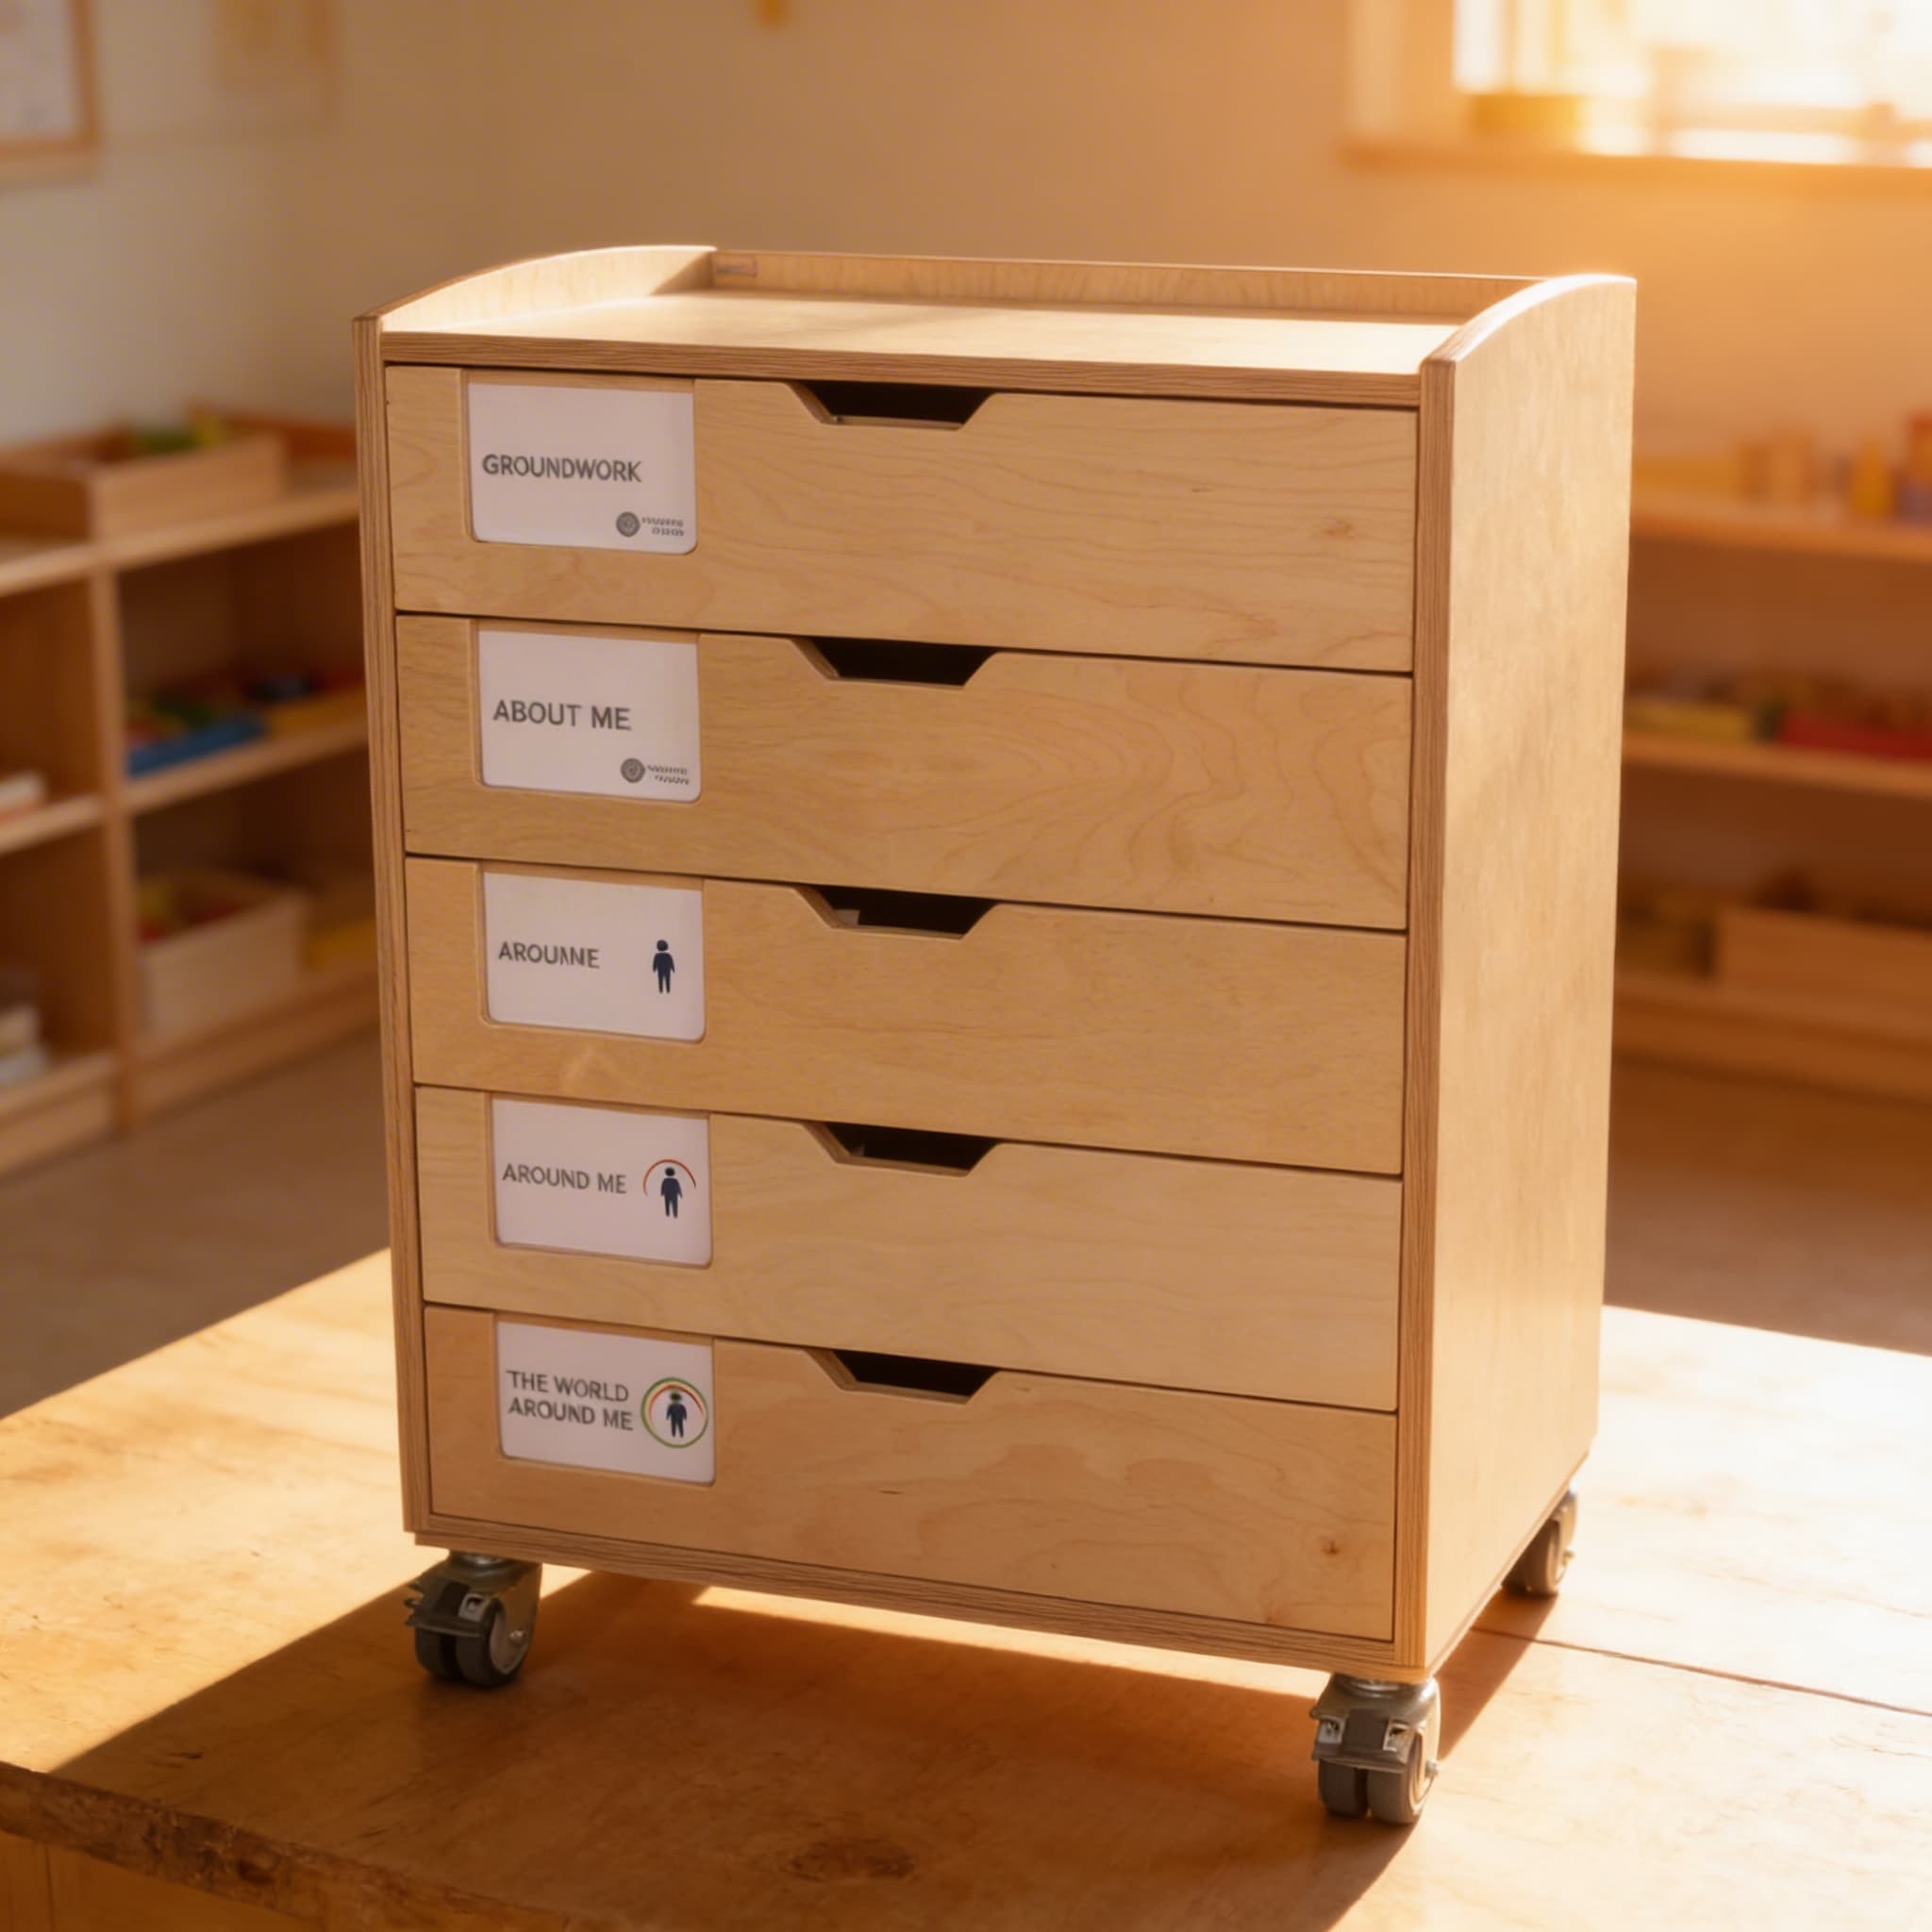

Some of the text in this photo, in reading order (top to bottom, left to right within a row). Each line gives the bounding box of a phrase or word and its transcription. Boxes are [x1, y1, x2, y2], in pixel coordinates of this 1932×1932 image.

[482, 454, 642, 483] GROUNDWORK
[492, 699, 632, 731] ABOUT ME
[502, 1163, 627, 1194] AROUND ME
[506, 1370, 629, 1403] THE WORLD
[508, 1397, 634, 1431] AROUND ME
